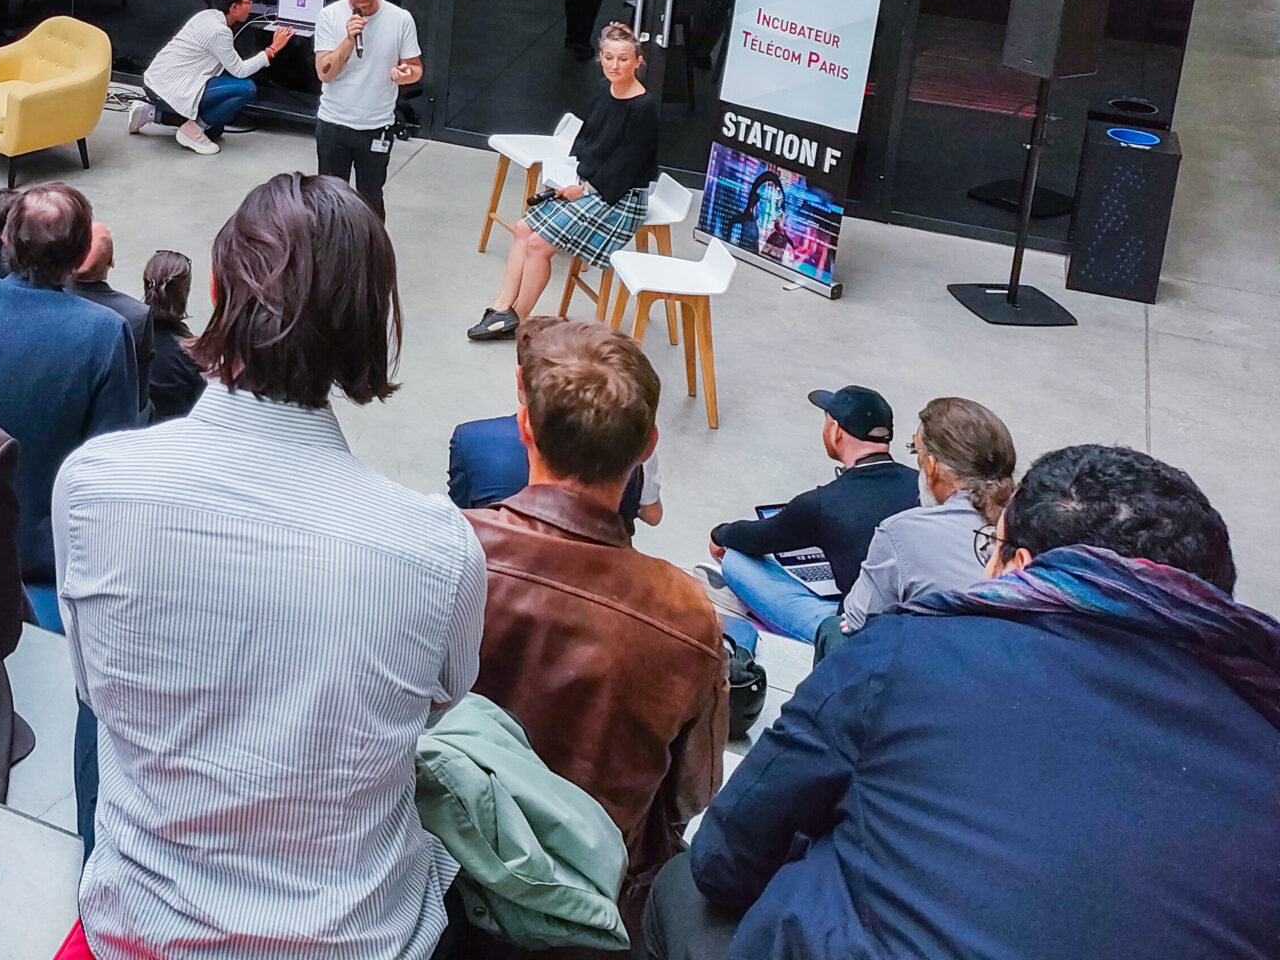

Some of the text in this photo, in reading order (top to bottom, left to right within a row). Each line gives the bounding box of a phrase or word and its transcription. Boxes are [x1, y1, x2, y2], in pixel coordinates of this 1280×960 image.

[756, 7, 841, 49] INCUBATEUR
[742, 29, 849, 81] TÉLÉCOM PARIS
[721, 111, 842, 174] STATION F
